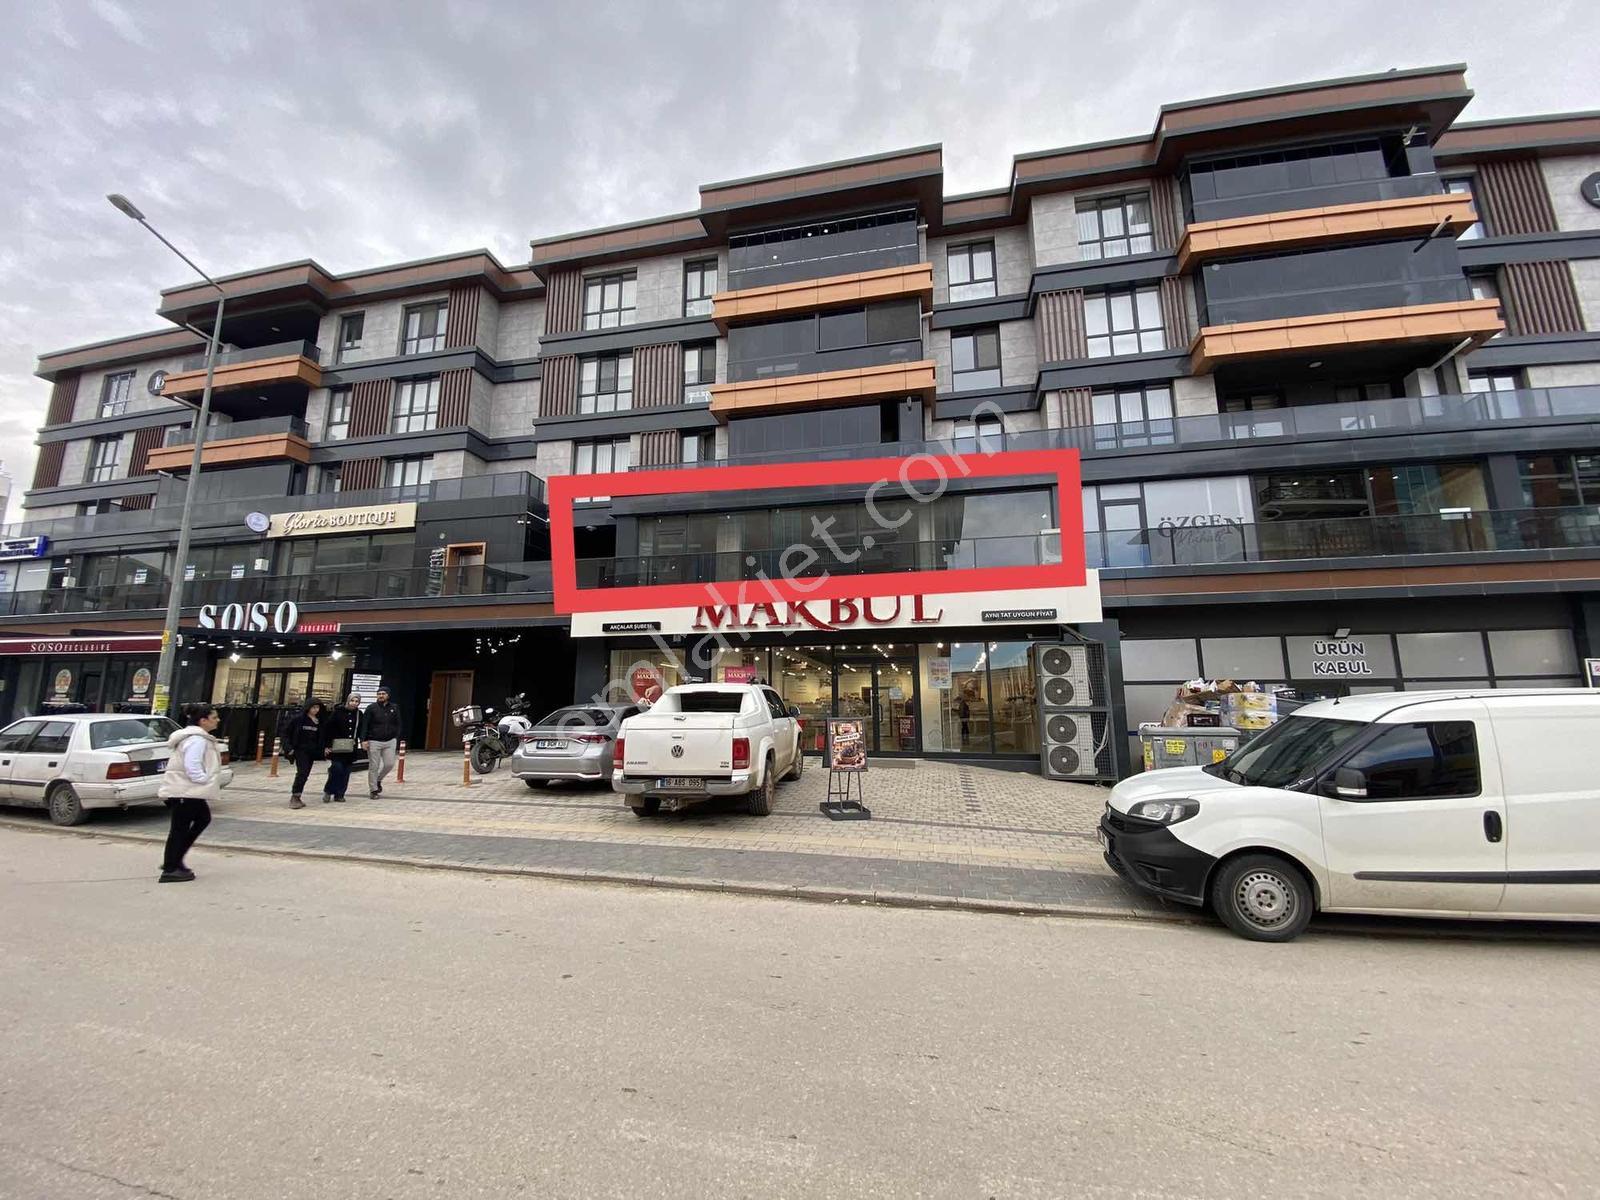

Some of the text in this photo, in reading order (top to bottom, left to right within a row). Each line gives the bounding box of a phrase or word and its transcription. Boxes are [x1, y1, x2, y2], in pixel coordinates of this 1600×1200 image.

[283, 511, 327, 535] Gloria
[328, 510, 396, 527] BOUTIQUE
[1158, 514, 1244, 538] ÖZGEN
[1313, 640, 1365, 656] ÜRÜN
[1312, 660, 1372, 675] KABUL
